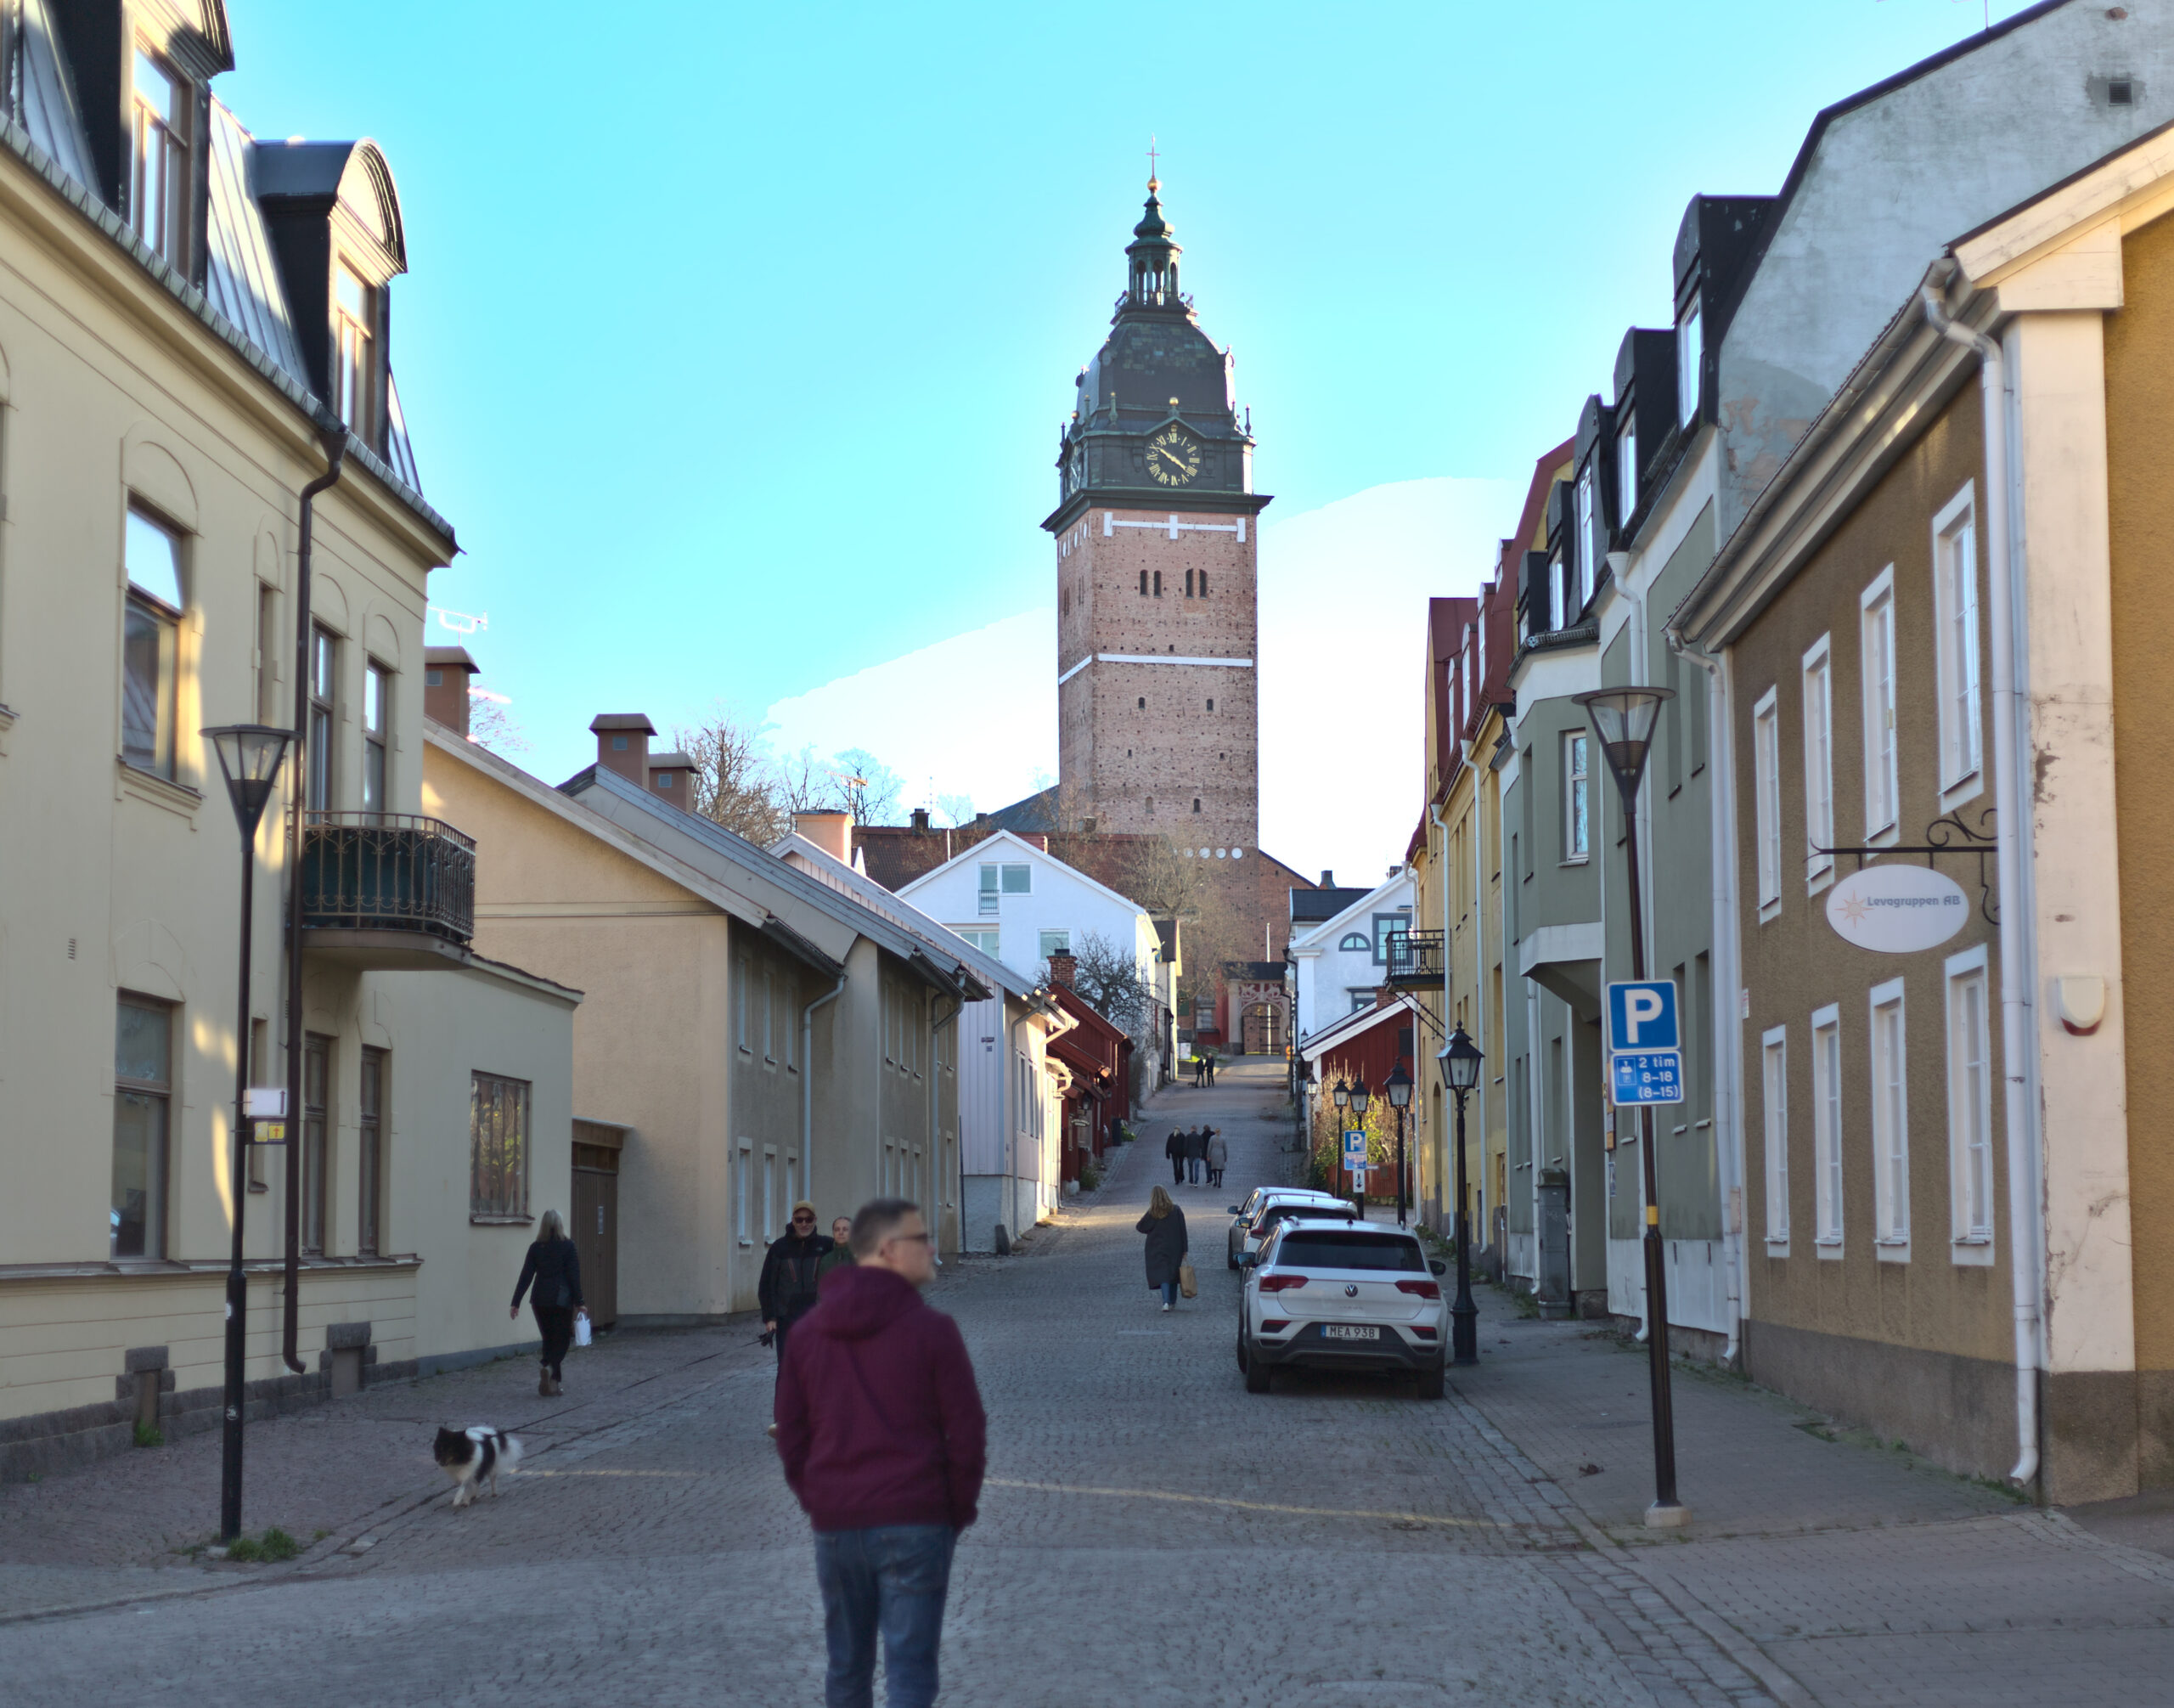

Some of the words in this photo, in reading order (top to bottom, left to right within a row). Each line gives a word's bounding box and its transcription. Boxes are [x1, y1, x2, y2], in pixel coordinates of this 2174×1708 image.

[1867, 897, 1939, 907] Levagruppen
[1943, 895, 1961, 906] AB
[1624, 988, 1664, 1044] P
[1638, 1057, 1647, 1068] 2
[1653, 1057, 1676, 1068] tim
[1642, 1070, 1673, 1083] 8-18
[1350, 1133, 1362, 1150] P
[1330, 1326, 1351, 1337] MEA
[1354, 1327, 1375, 1339] 93B
